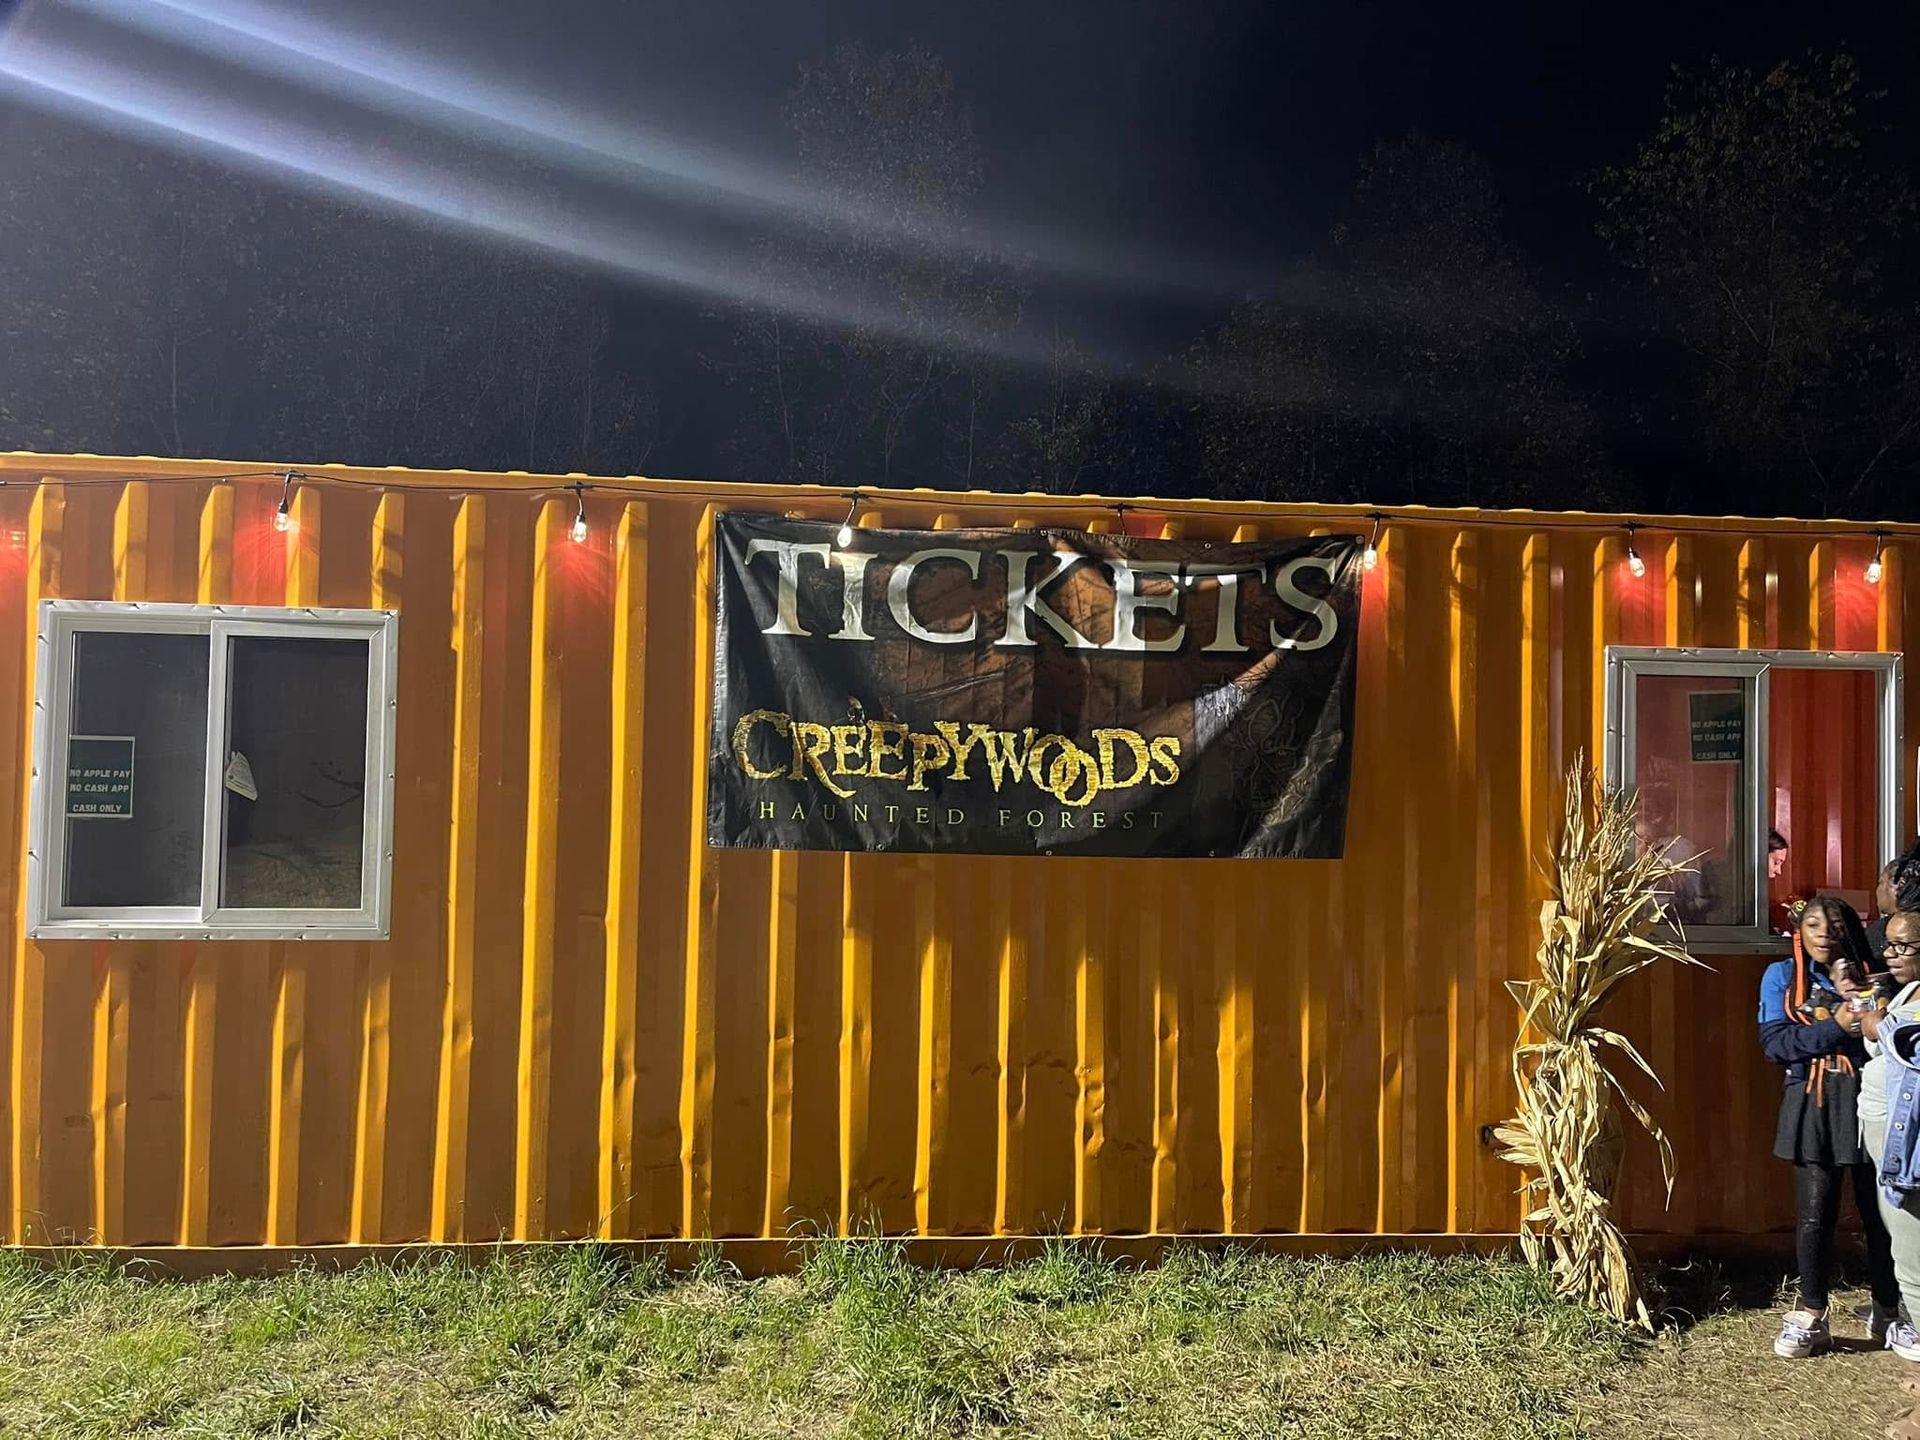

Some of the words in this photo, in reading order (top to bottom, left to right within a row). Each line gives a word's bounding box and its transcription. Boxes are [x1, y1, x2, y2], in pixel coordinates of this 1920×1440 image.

[744, 539, 1340, 653] TICKETS
[1703, 720, 1726, 728] APPLE
[1727, 720, 1741, 728] PAY
[731, 707, 1181, 807] CREEPYWOODS
[69, 769, 81, 777] NO
[84, 769, 111, 777] APPLE
[113, 770, 131, 778] PAY
[70, 784, 82, 793] NO
[84, 784, 108, 792] CASH
[111, 784, 129, 793] APP
[72, 804, 97, 812] CASH
[99, 804, 122, 812] ONLY
[759, 801, 965, 827] HAUNTED
[1000, 809, 1164, 831] FOREST
